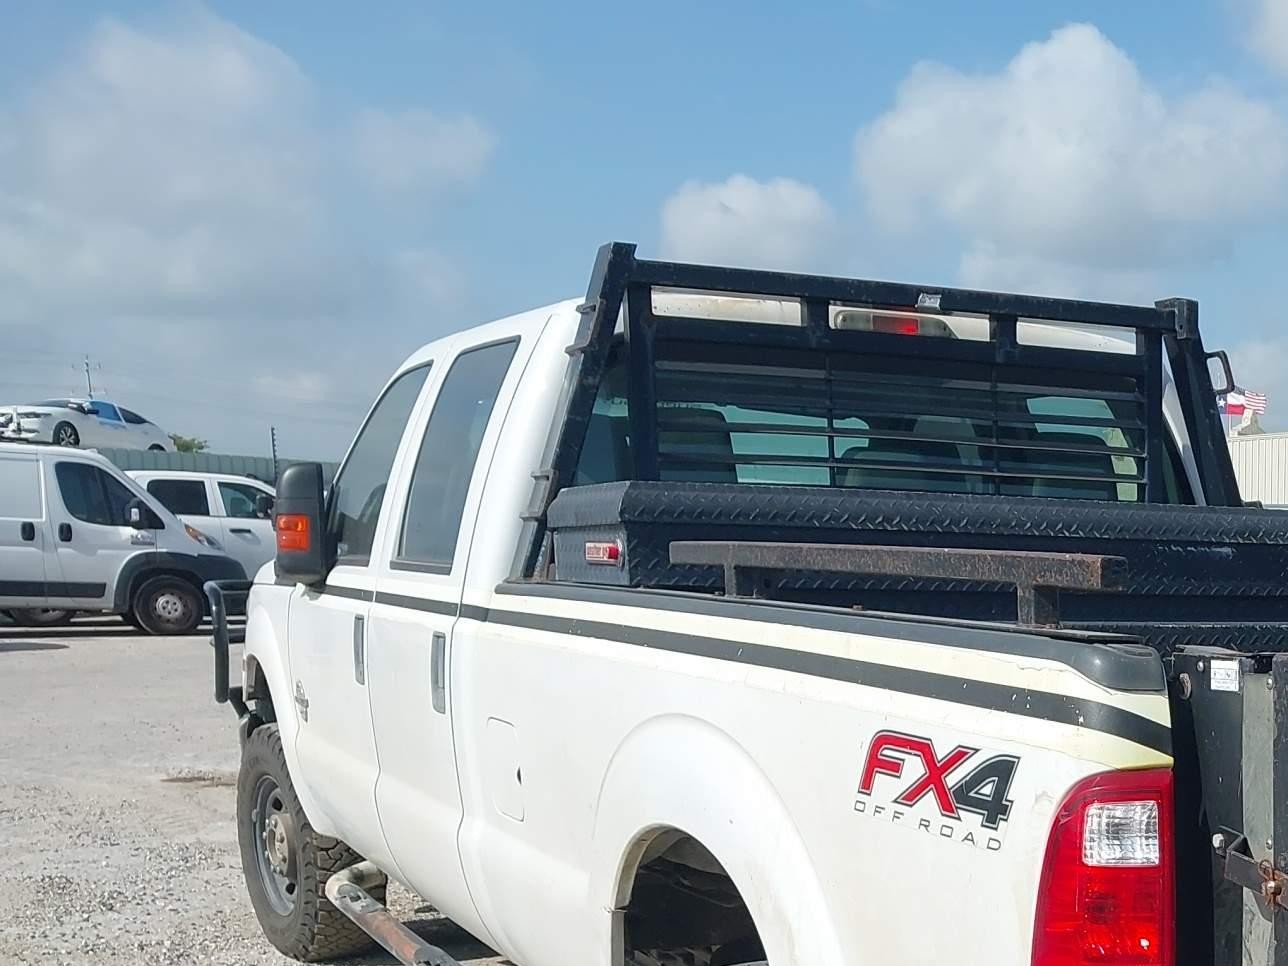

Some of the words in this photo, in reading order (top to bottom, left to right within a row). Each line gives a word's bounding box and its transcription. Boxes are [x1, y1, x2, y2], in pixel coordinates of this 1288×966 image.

[857, 729, 1021, 831] FX4
[854, 800, 904, 822] OFF
[918, 818, 1002, 851] ROAD
